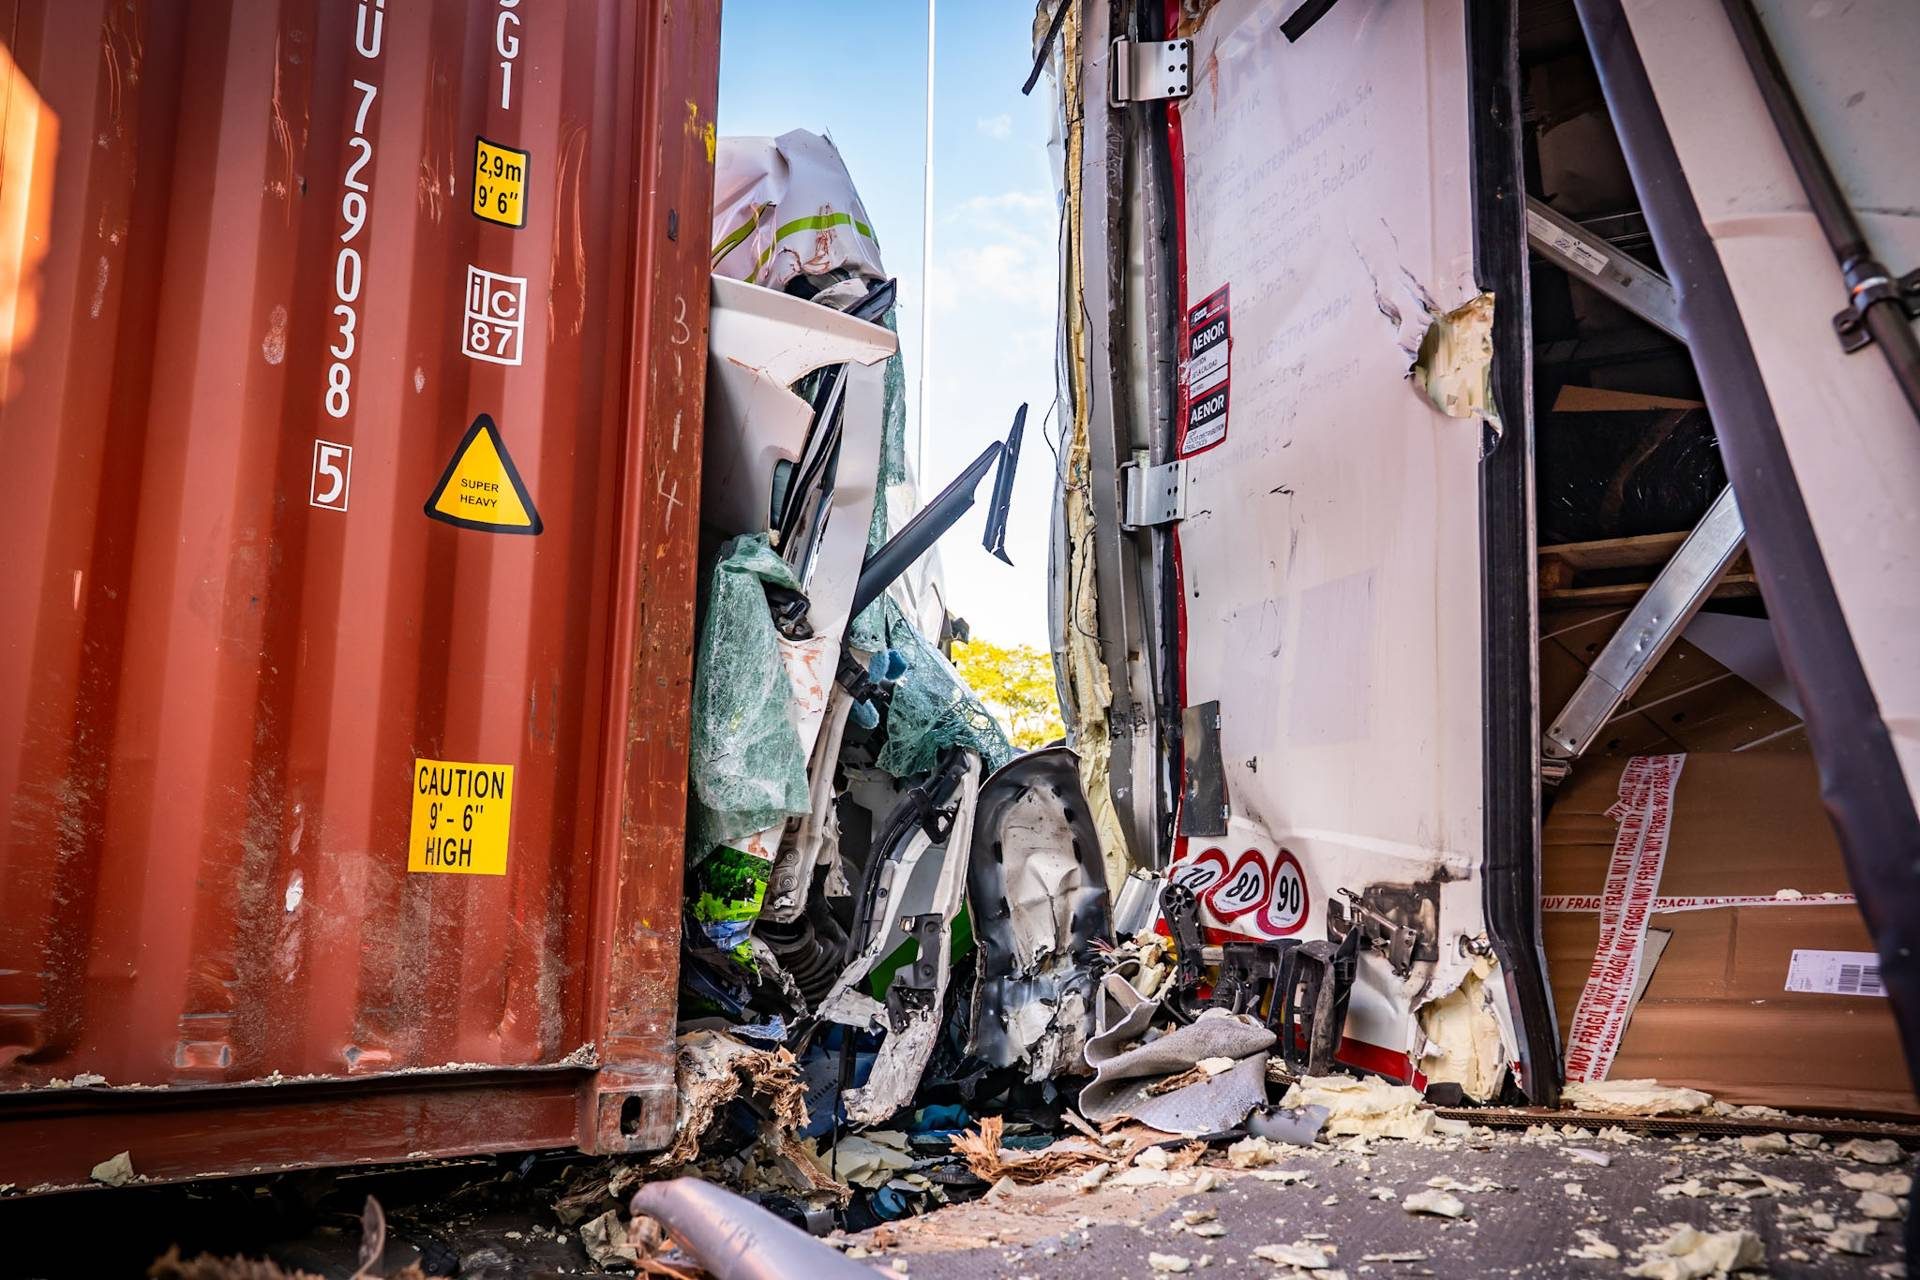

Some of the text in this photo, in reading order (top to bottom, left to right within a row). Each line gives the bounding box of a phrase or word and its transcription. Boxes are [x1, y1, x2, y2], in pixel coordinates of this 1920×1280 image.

[355, 0, 384, 58] U
[496, 0, 521, 110] G1
[480, 150, 521, 182] 2,9m
[470, 322, 513, 354] 87
[1192, 321, 1225, 353] AENOR
[1190, 394, 1224, 424] AENOR
[461, 478, 499, 493] SUPER
[460, 494, 497, 508] HEAVY
[418, 766, 505, 799] CAUTION
[1622, 814, 1644, 829] MUY
[1649, 808, 1667, 834] FRAGIL
[425, 837, 472, 867] HIGH
[1615, 831, 1640, 857] FRAGIL
[1644, 836, 1663, 852] MUY
[1611, 858, 1632, 875] MUY
[1637, 853, 1660, 881] FRAGIL
[1226, 872, 1260, 902] 80
[1277, 875, 1300, 915] 90
[1605, 877, 1628, 906] FRAGIL
[1631, 882, 1654, 900] MUY
[1566, 897, 1601, 909] FRAG
[1602, 908, 1621, 925] MUY
[1623, 902, 1649, 930] FRAGIL
[1615, 931, 1638, 952] MUY
[1602, 954, 1631, 985] FRAGIL
[1593, 985, 1618, 1008] MUY
[1578, 1010, 1609, 1045] FRAGIL
[1568, 1046, 1594, 1072] MUY
